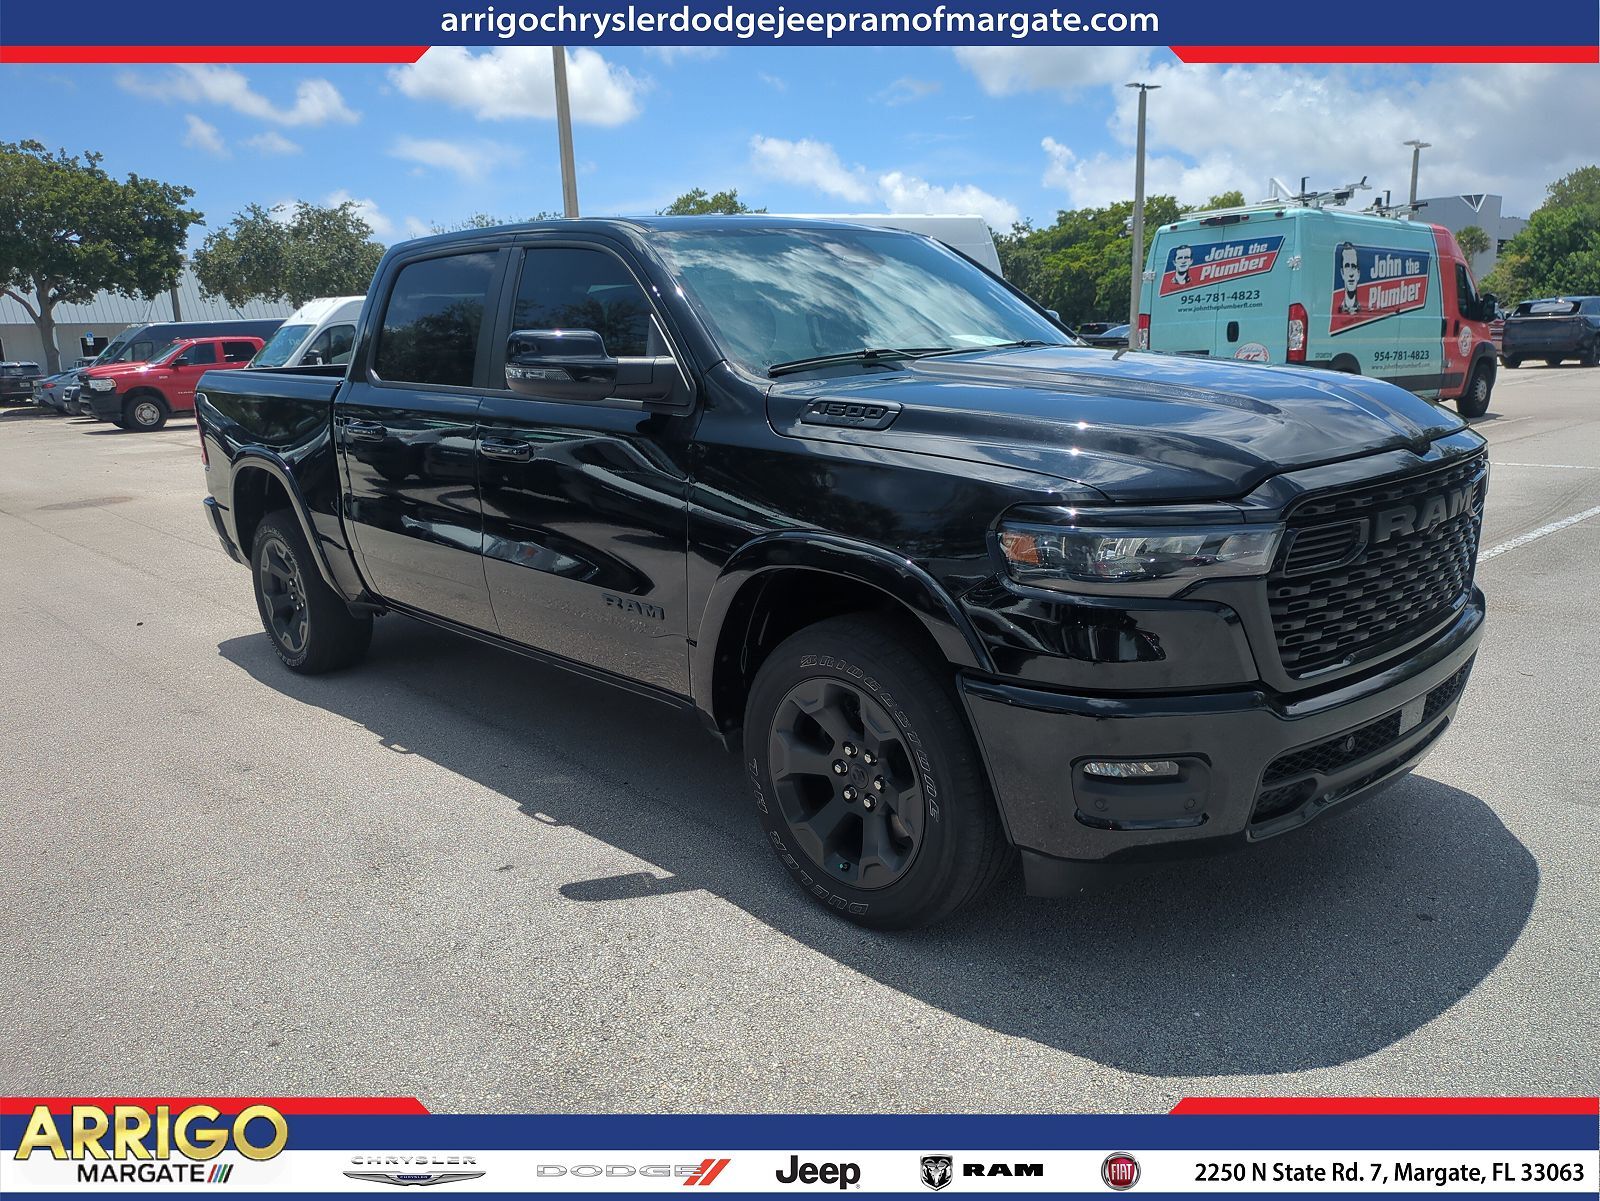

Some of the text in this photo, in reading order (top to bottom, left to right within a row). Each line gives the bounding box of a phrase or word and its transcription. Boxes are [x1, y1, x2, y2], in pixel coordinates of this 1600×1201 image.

[1204, 242, 1268, 262] John the
[1199, 256, 1268, 281] Plumber
[1370, 254, 1420, 279] John the
[1180, 290, 1261, 305] 954-781-4823
[1368, 281, 1421, 312] Plumber
[1374, 350, 1430, 362] 954-781-4823
[810, 402, 887, 419] 1500
[1375, 483, 1473, 544] RAM
[601, 592, 665, 621] RAM
[769, 830, 869, 917] DUELER
